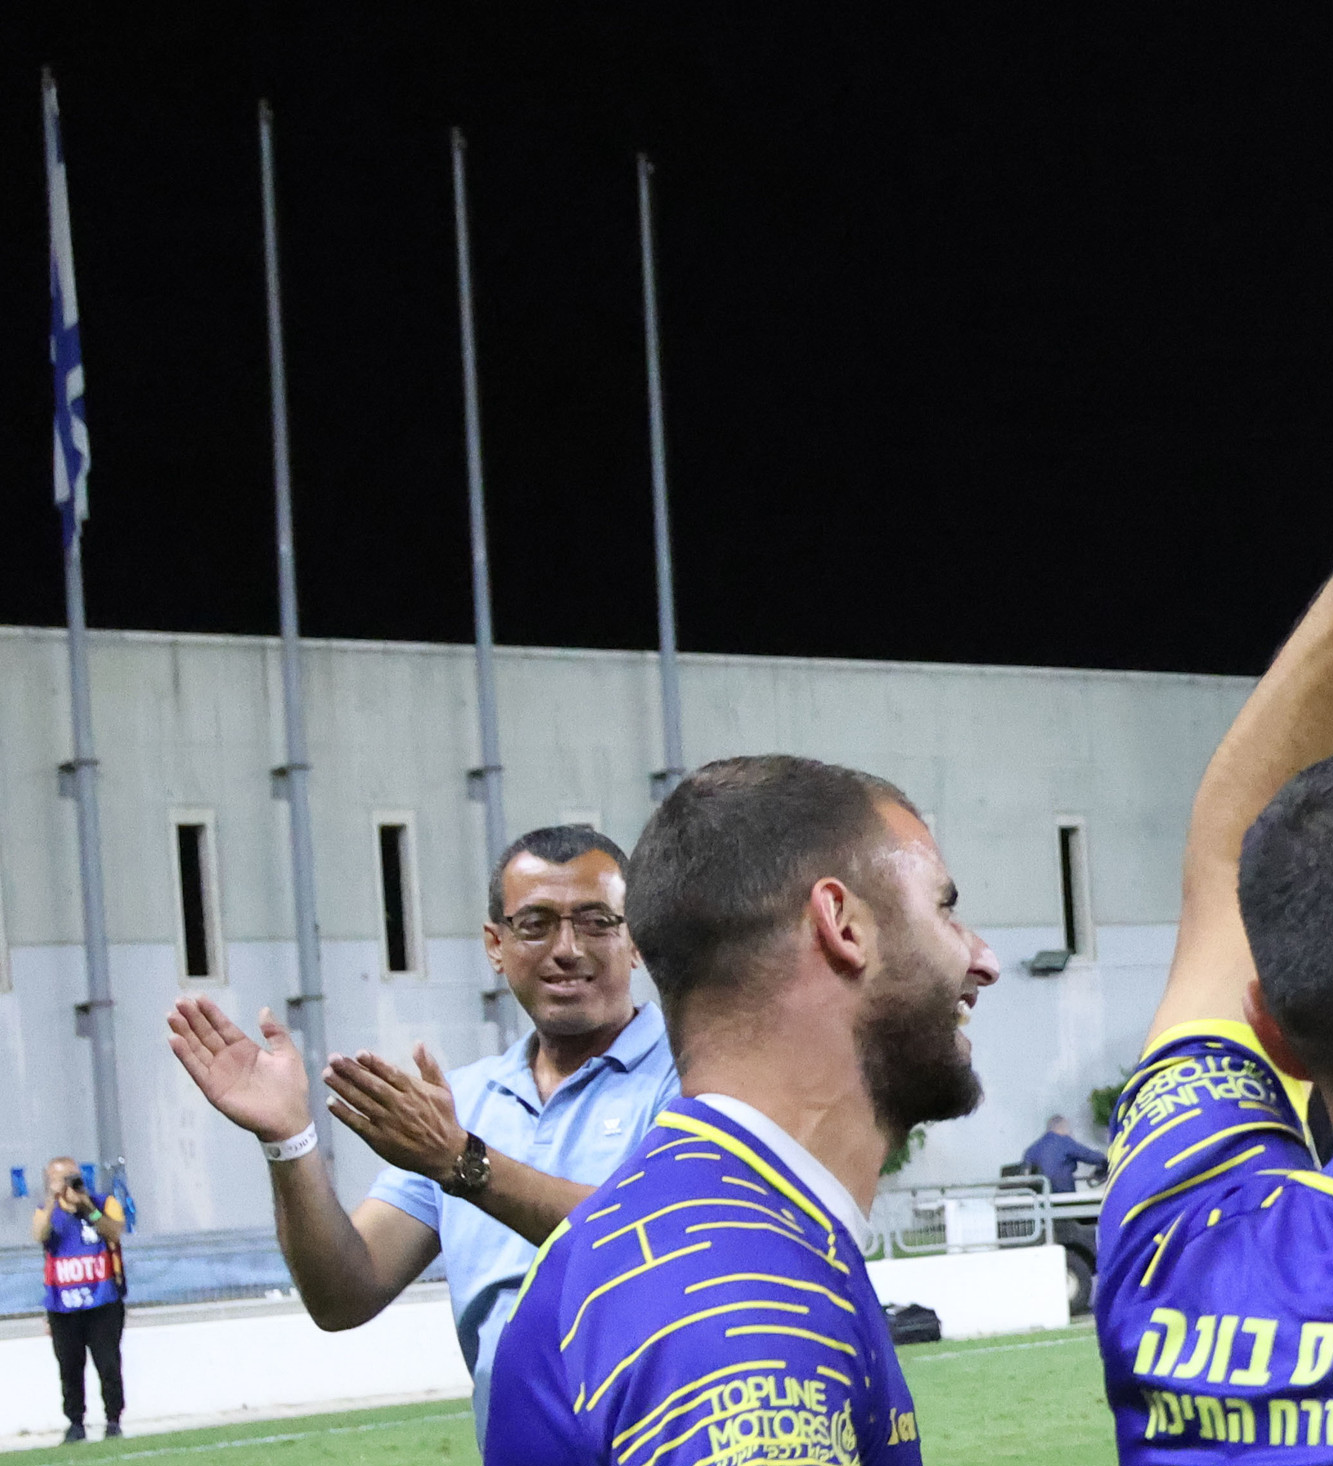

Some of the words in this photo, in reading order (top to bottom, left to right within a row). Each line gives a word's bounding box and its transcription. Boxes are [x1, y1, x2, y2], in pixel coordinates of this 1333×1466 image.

[1146, 1075, 1276, 1126] OPLINE
[1133, 1307, 1278, 1386] בונה
[711, 1376, 828, 1417] TOPLINE
[708, 1409, 832, 1459] MOTORS
